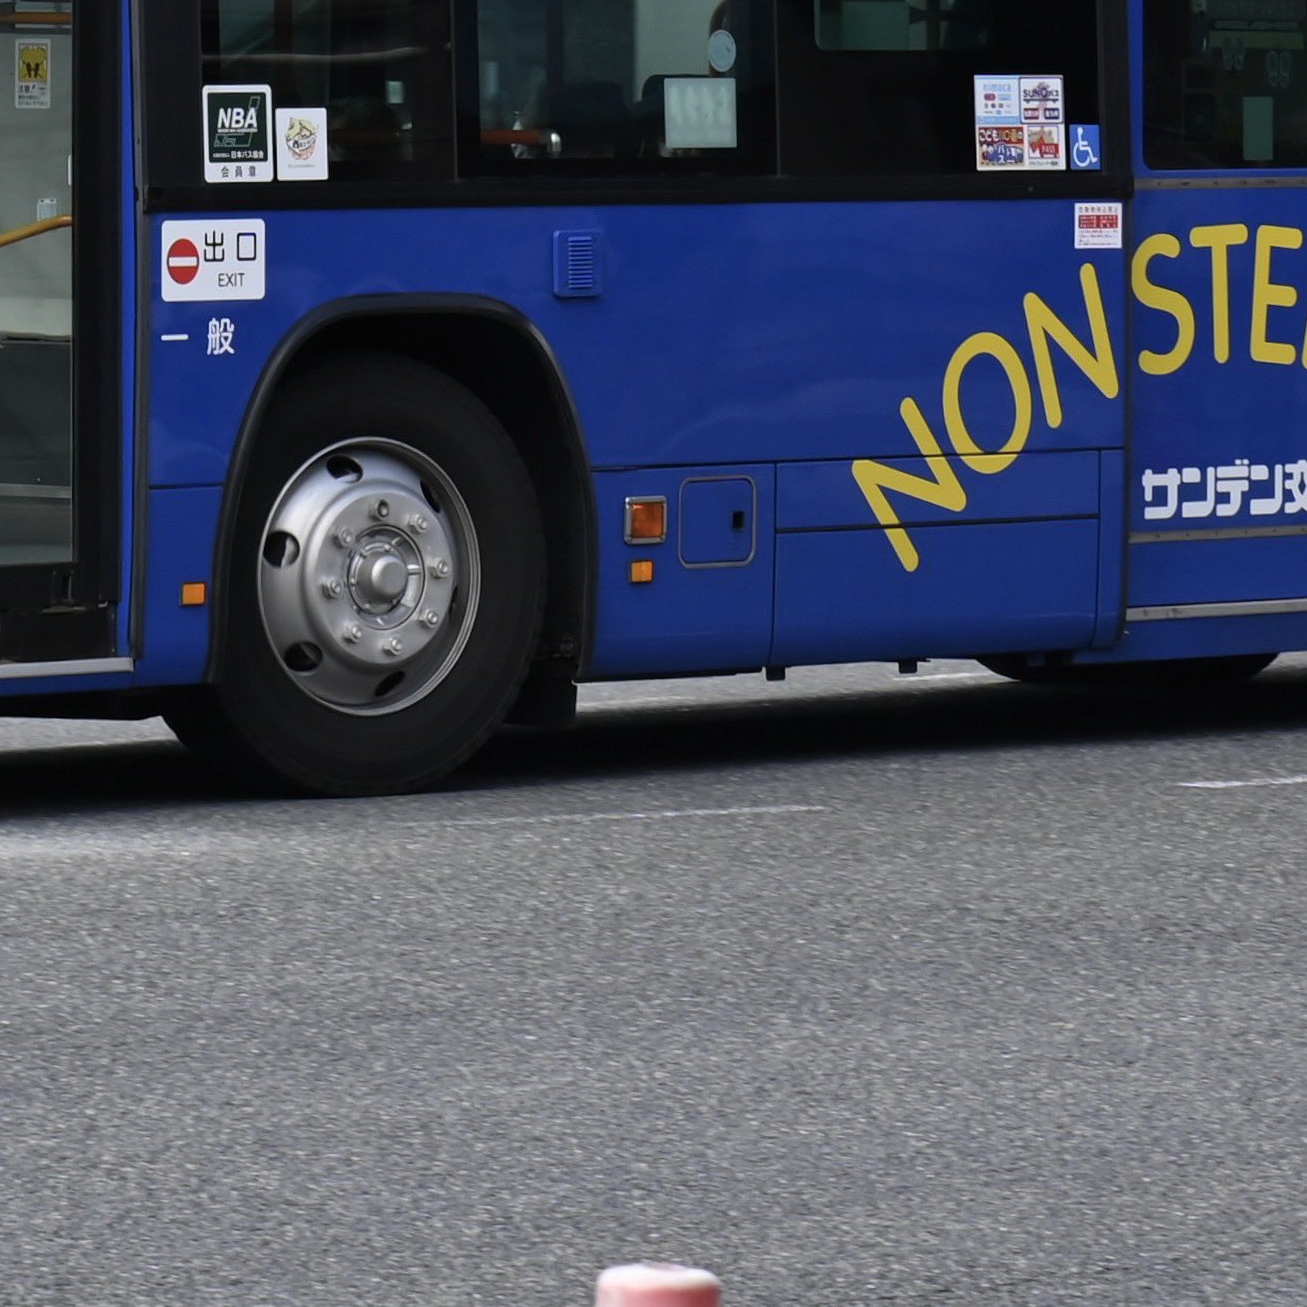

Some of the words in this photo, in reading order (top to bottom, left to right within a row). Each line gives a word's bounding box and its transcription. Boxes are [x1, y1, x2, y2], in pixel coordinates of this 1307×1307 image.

[217, 107, 258, 128] NBA
[204, 230, 257, 263] 出口
[218, 272, 245, 287] EXIT
[161, 317, 235, 355] 一般
[851, 262, 1119, 572] NON
